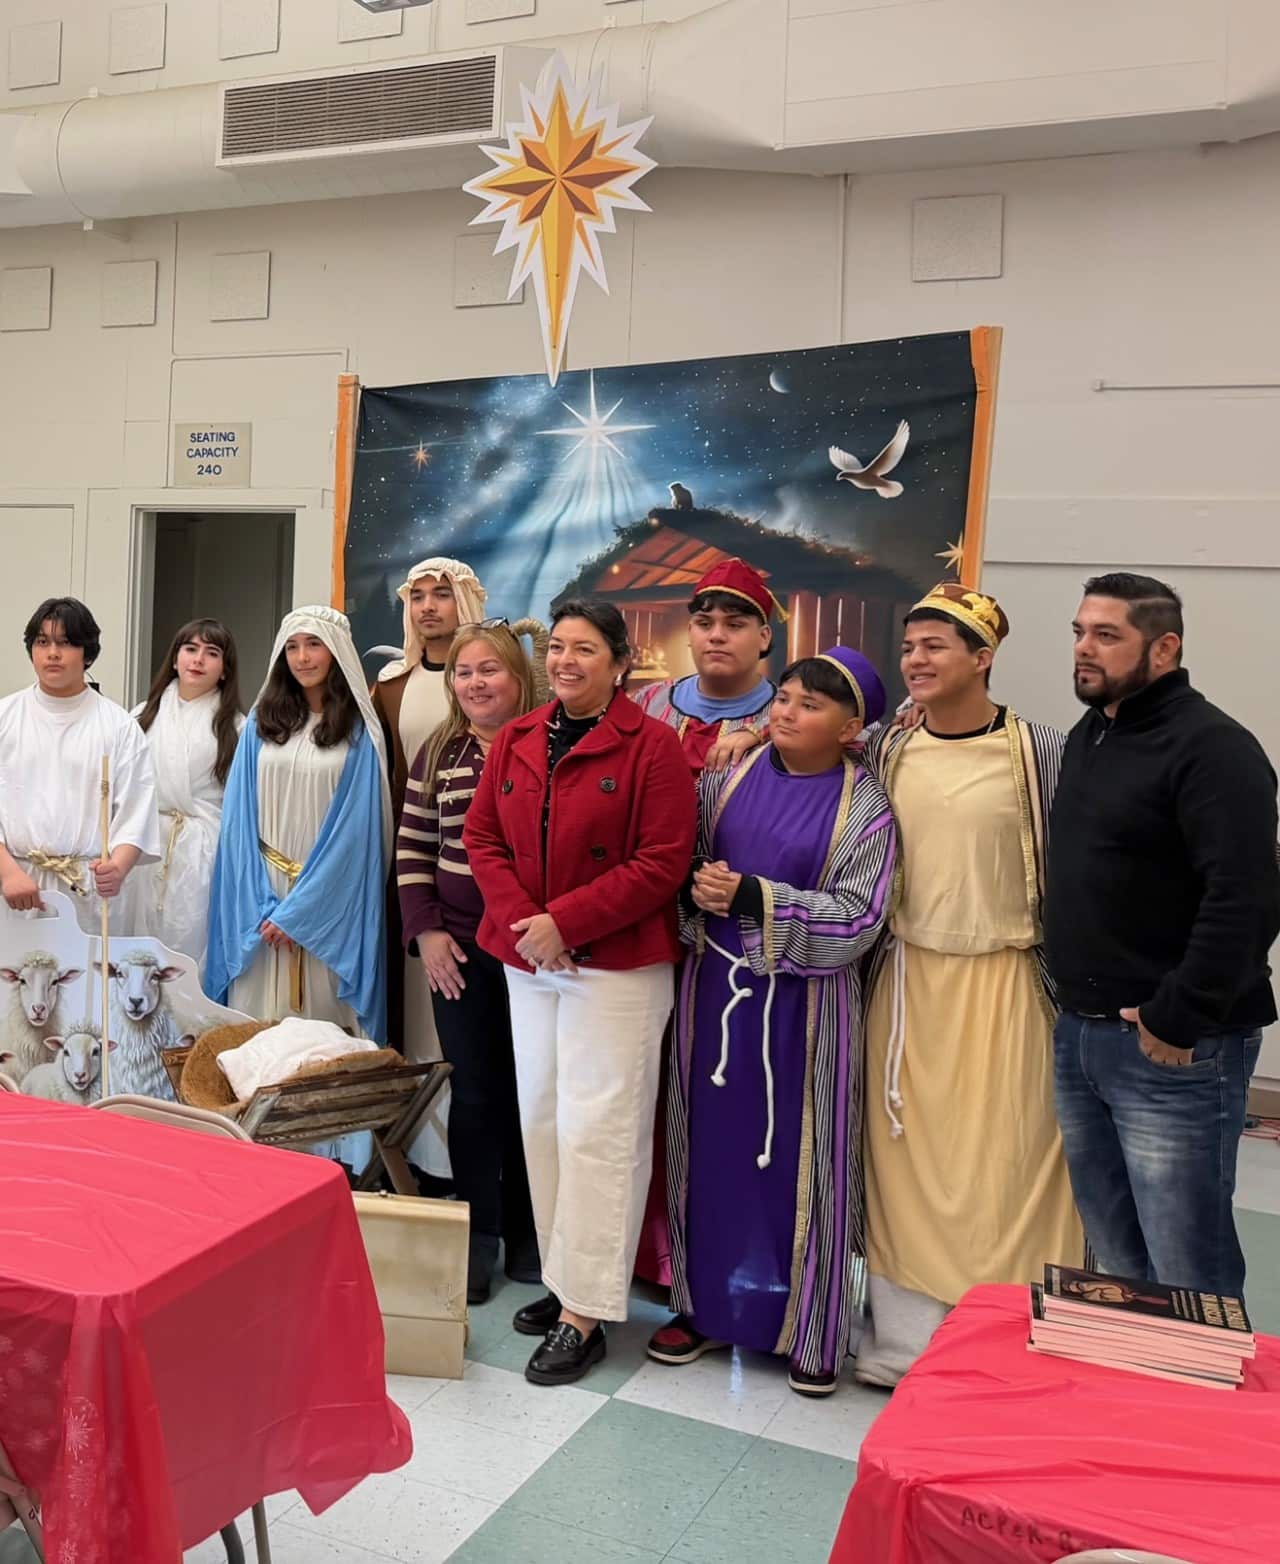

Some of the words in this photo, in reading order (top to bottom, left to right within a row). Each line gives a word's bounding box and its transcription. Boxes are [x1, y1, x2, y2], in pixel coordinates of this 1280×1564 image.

[190, 432, 236, 443] SEATING
[186, 447, 239, 459] CAPACITY
[197, 464, 223, 476] 240
